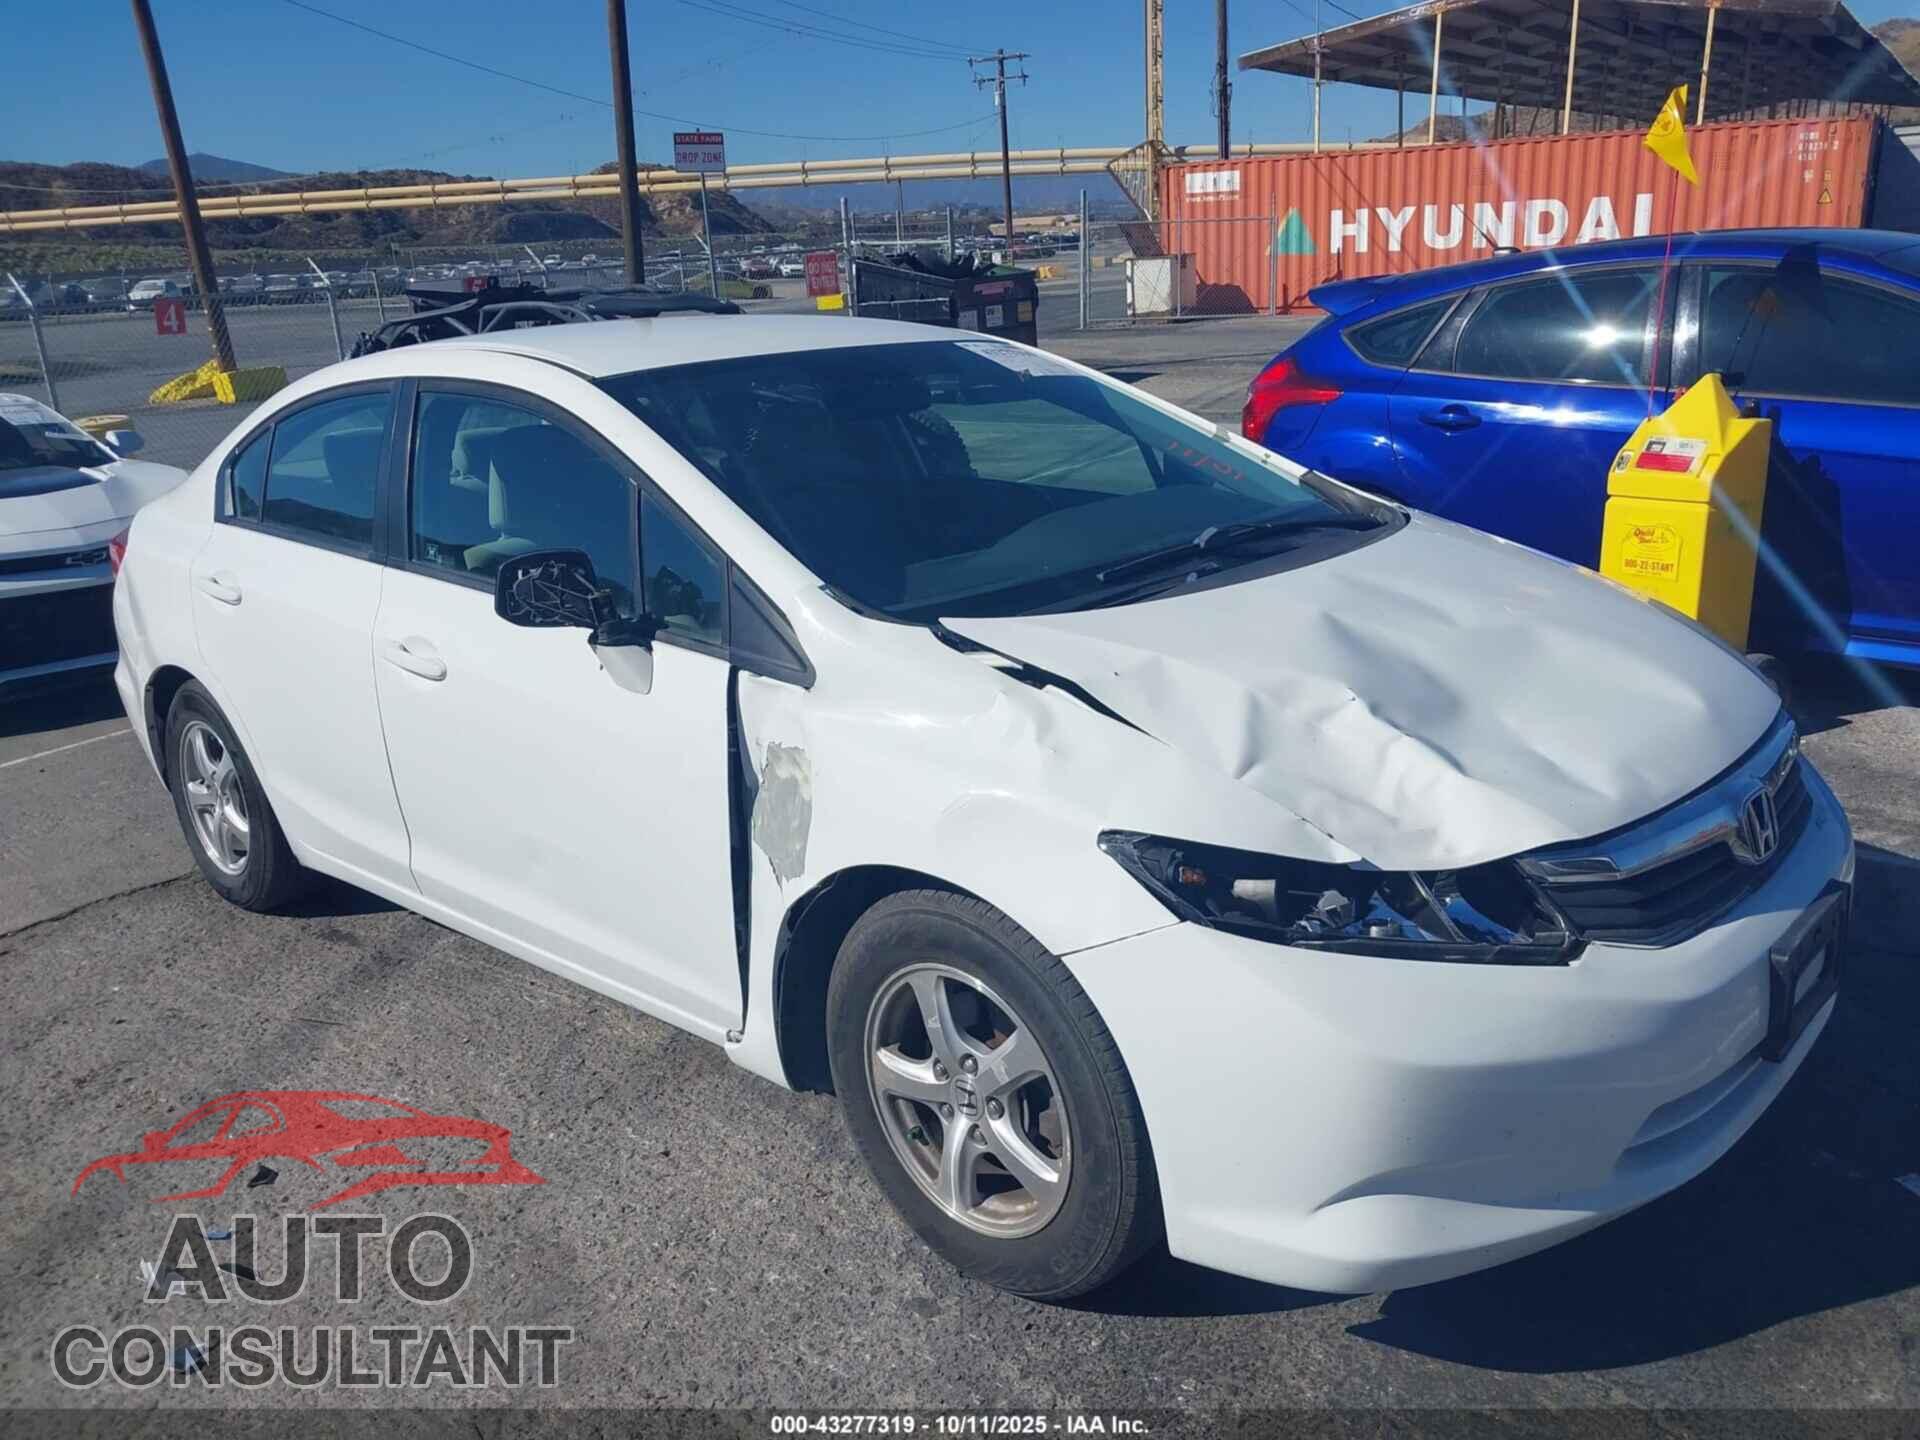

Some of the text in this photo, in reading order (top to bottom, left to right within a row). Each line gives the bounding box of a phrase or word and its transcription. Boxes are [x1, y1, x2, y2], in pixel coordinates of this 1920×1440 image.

[675, 135, 722, 144] STATE FARM
[677, 151, 722, 163] DROP ZONE
[1330, 193, 1654, 255] HYUNDAI
[809, 260, 835, 273] DO NOT
[811, 275, 836, 289] ENTER
[163, 303, 178, 331] 4
